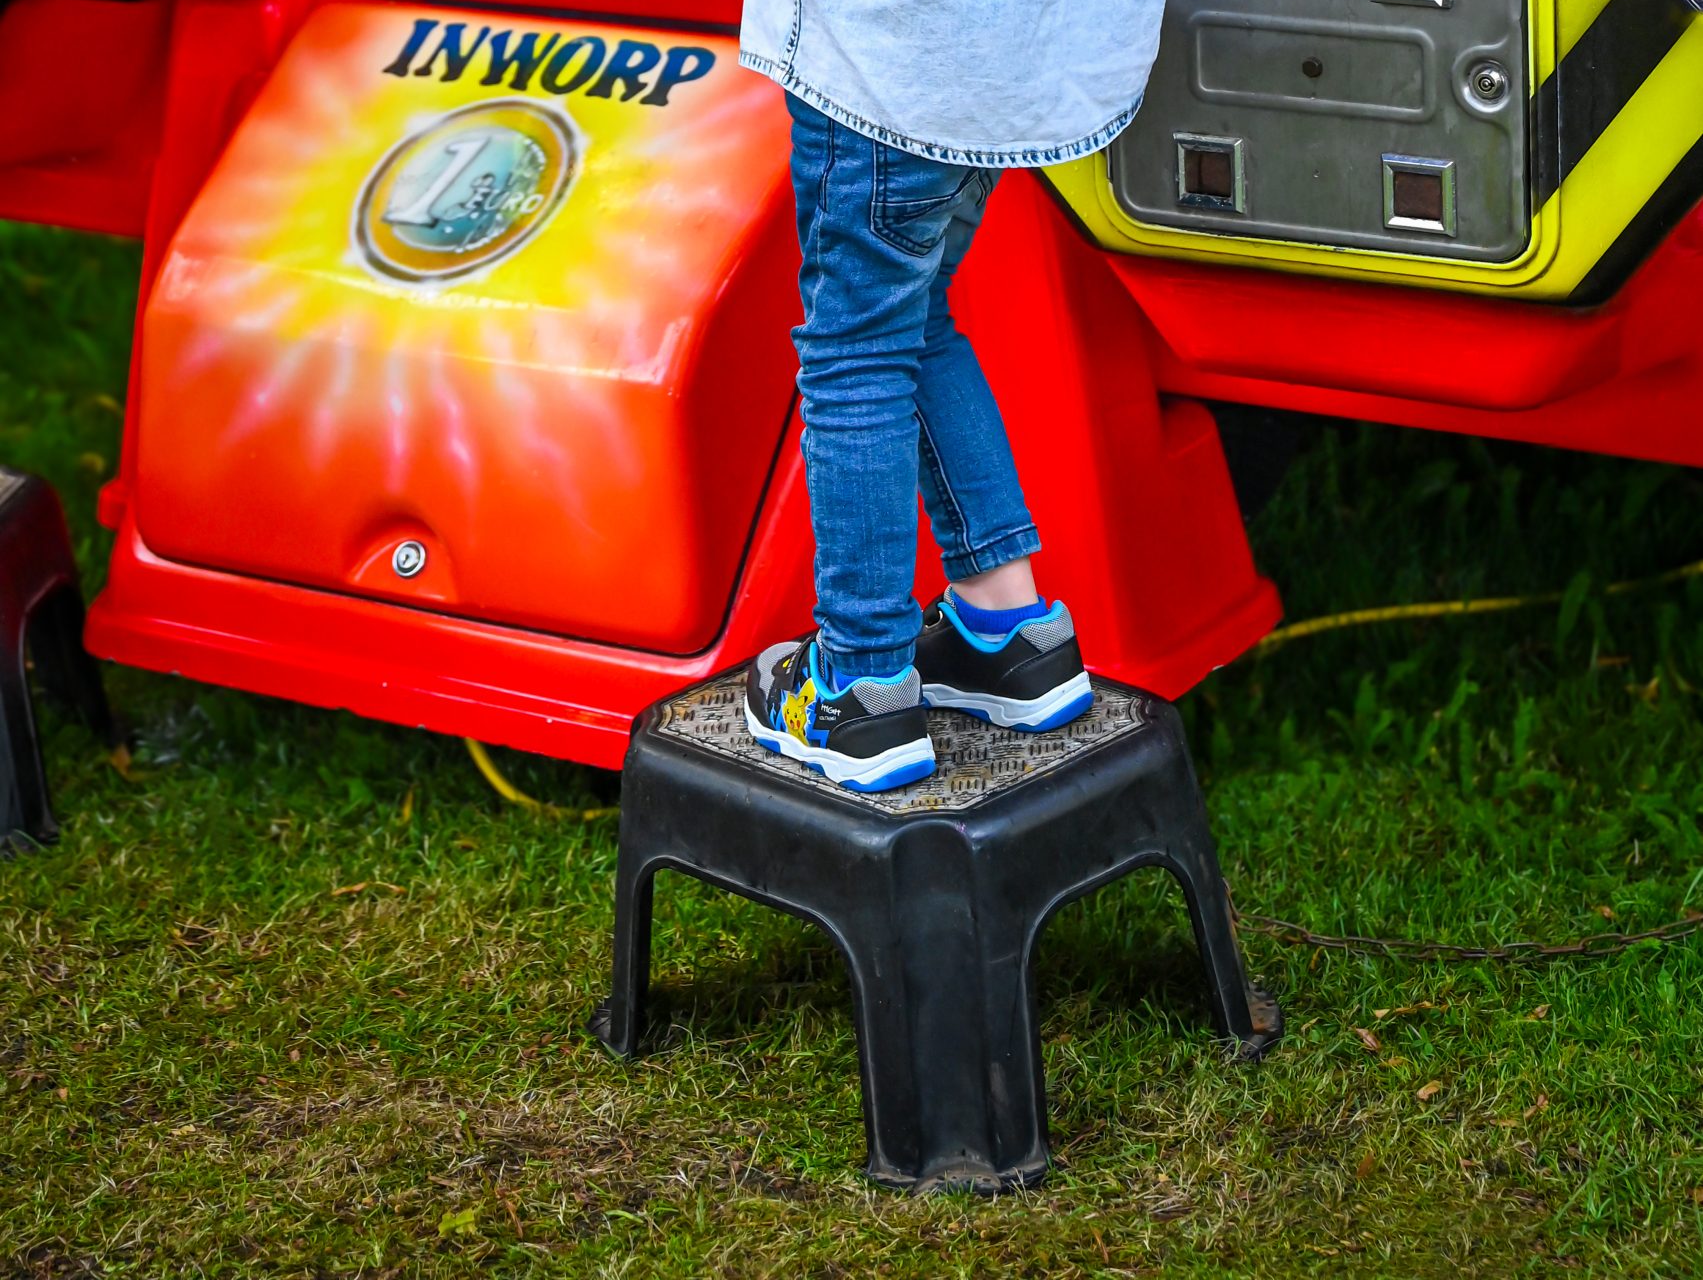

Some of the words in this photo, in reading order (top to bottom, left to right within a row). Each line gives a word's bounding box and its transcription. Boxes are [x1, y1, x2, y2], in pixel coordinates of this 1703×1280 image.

[382, 18, 717, 107] INWORP
[382, 136, 493, 228] 1
[464, 186, 544, 215] EURO
